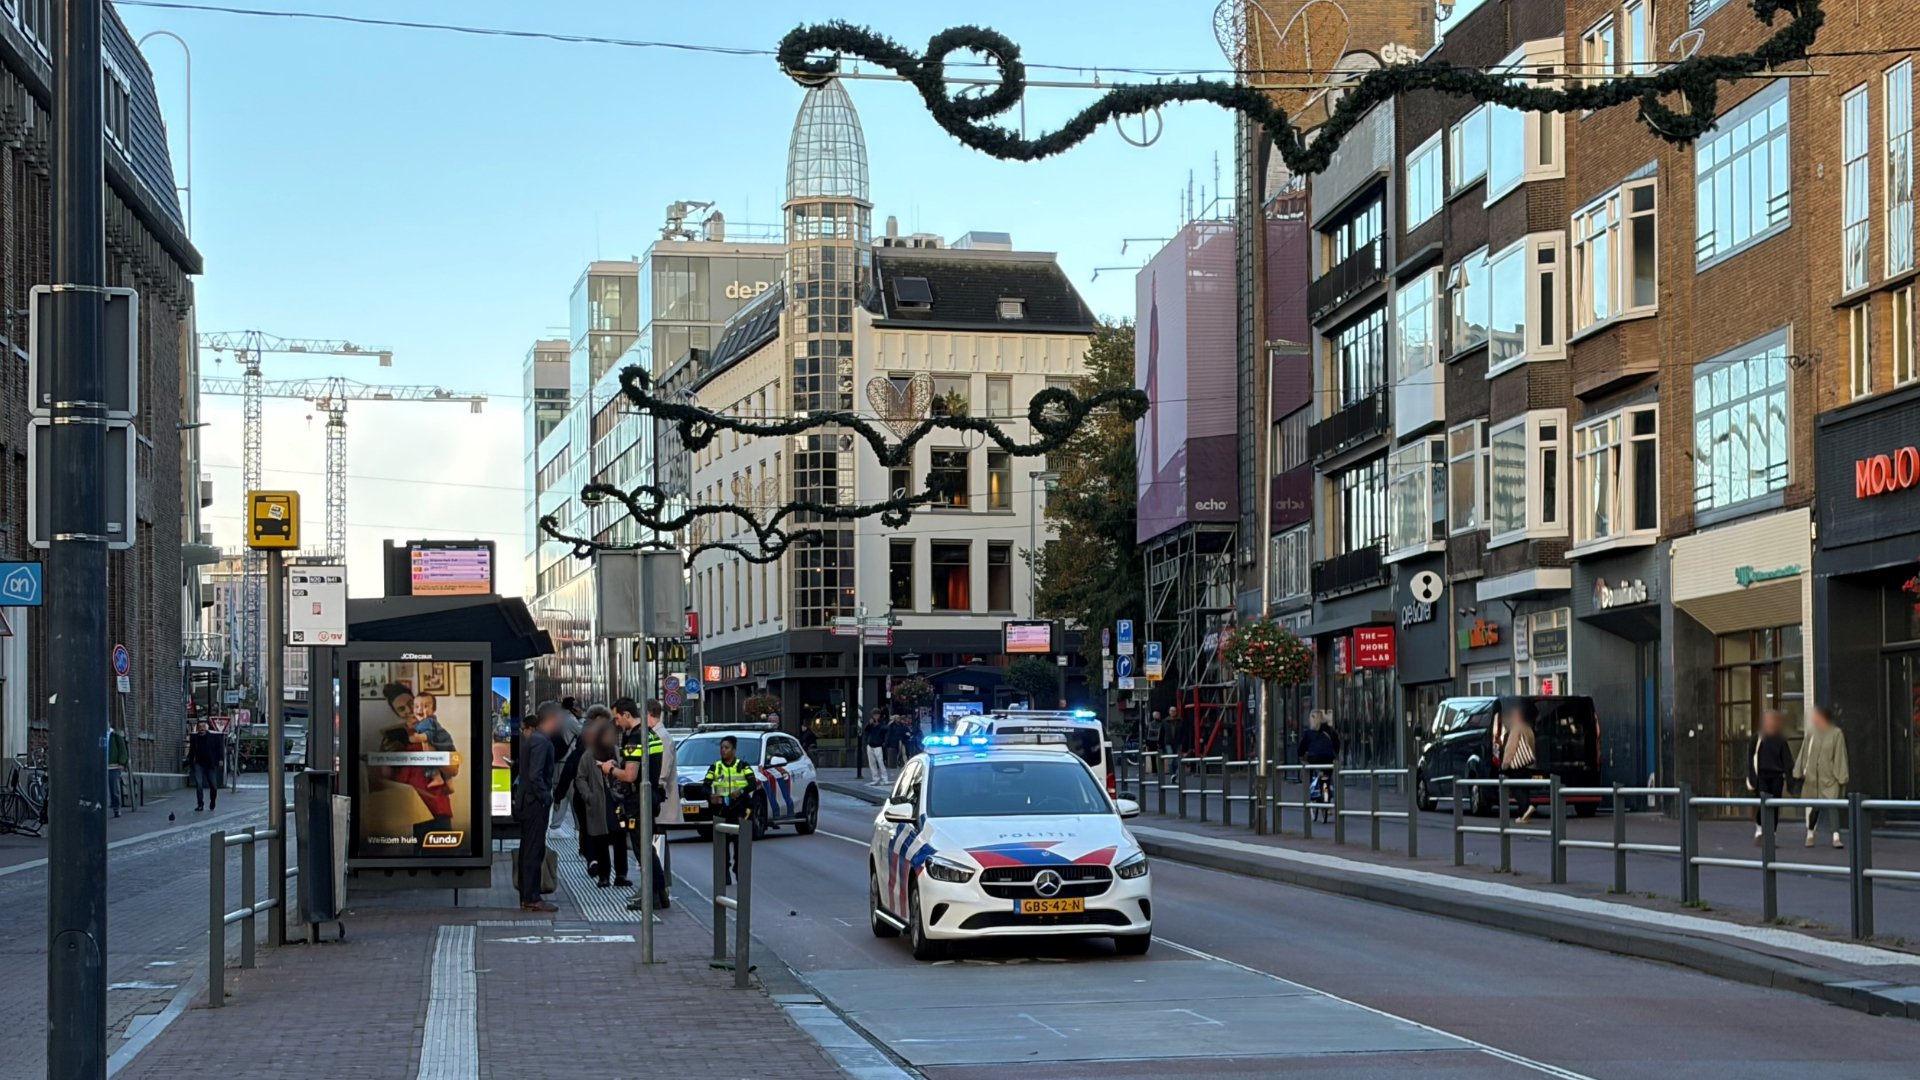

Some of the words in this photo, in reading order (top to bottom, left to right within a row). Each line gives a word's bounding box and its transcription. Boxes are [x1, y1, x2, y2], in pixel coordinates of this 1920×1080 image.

[1855, 446, 1920, 499] MOJO
[1195, 498, 1227, 511] echo
[1121, 622, 1129, 634] P
[1149, 643, 1158, 655] P
[1360, 643, 1389, 651] PHONE
[401, 836, 418, 844] huis
[428, 835, 457, 844] funda
[1024, 900, 1080, 912] GBS-42-N
